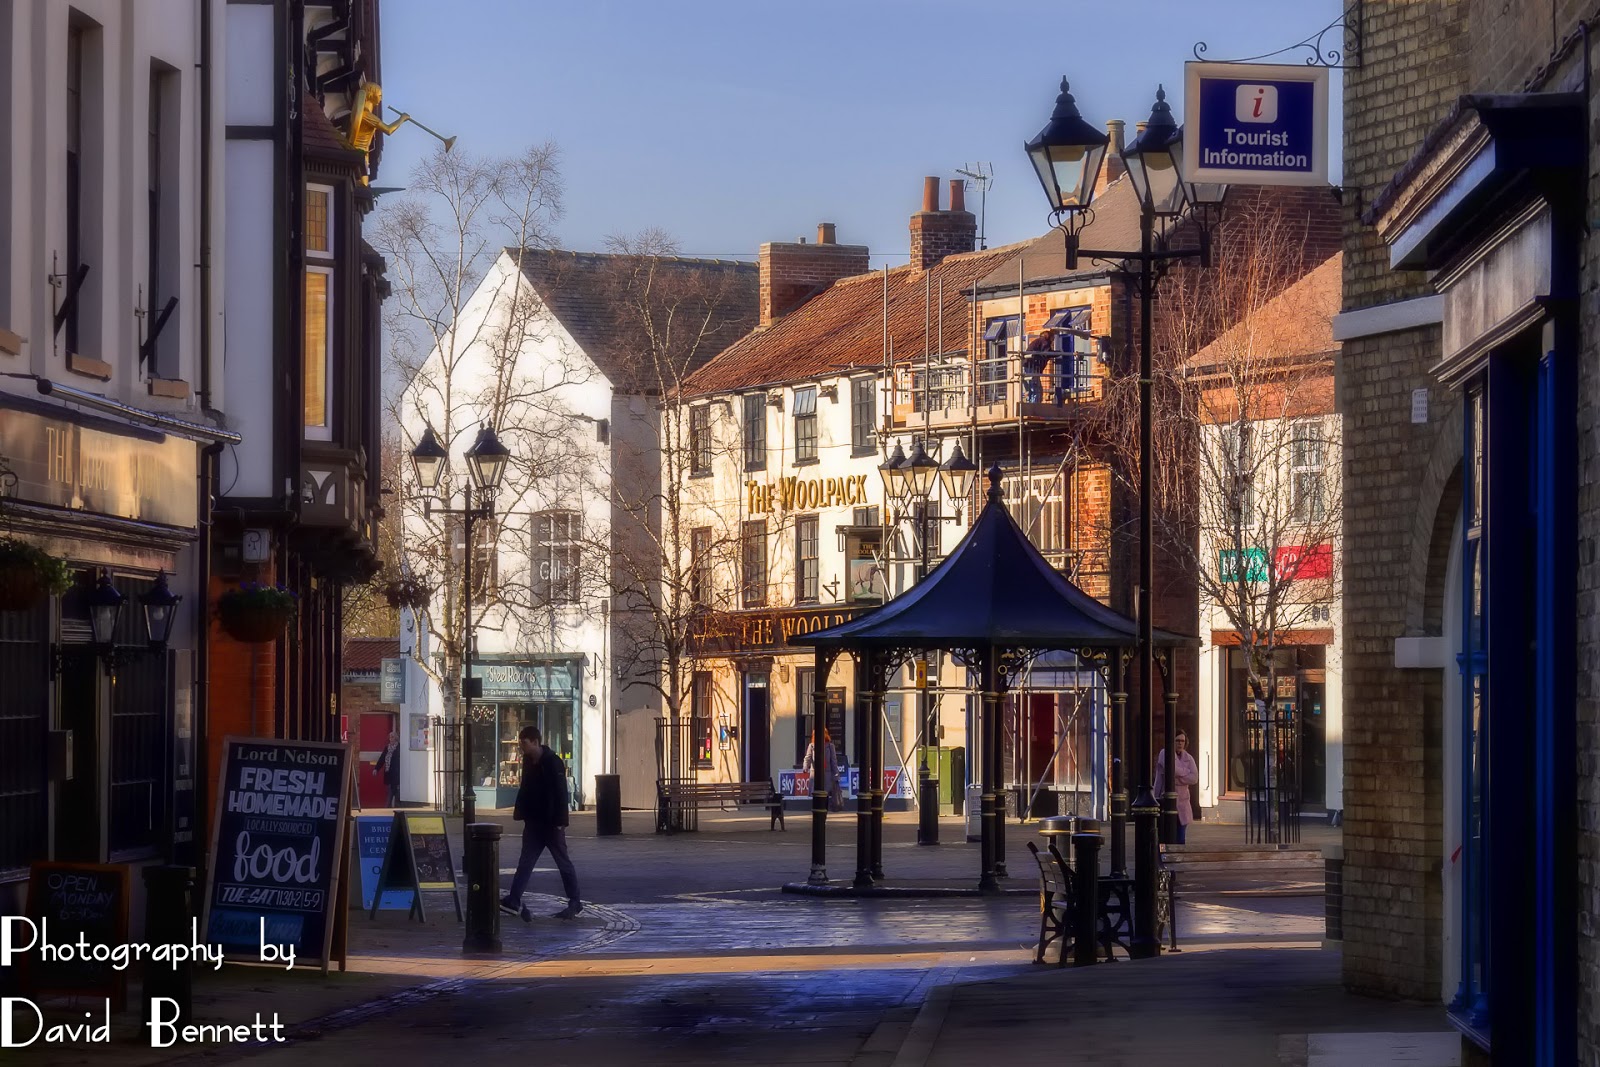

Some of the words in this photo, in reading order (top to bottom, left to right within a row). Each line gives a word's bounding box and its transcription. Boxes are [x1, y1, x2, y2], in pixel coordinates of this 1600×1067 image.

[1224, 128, 1289, 147] Tourist
[1204, 148, 1307, 168] Information
[745, 480, 776, 514] THE
[779, 474, 868, 511] WOOLPACK
[740, 619, 774, 645] THE
[237, 747, 278, 762] Lord
[283, 749, 338, 765] Nelson
[239, 767, 326, 795] FRESH
[781, 774, 795, 795] sky
[228, 790, 339, 820] HOMEMADE
[364, 836, 390, 844] HERIT
[234, 831, 321, 883] food
[48, 873, 98, 892] OPEN
[50, 888, 116, 908] MONDAY
